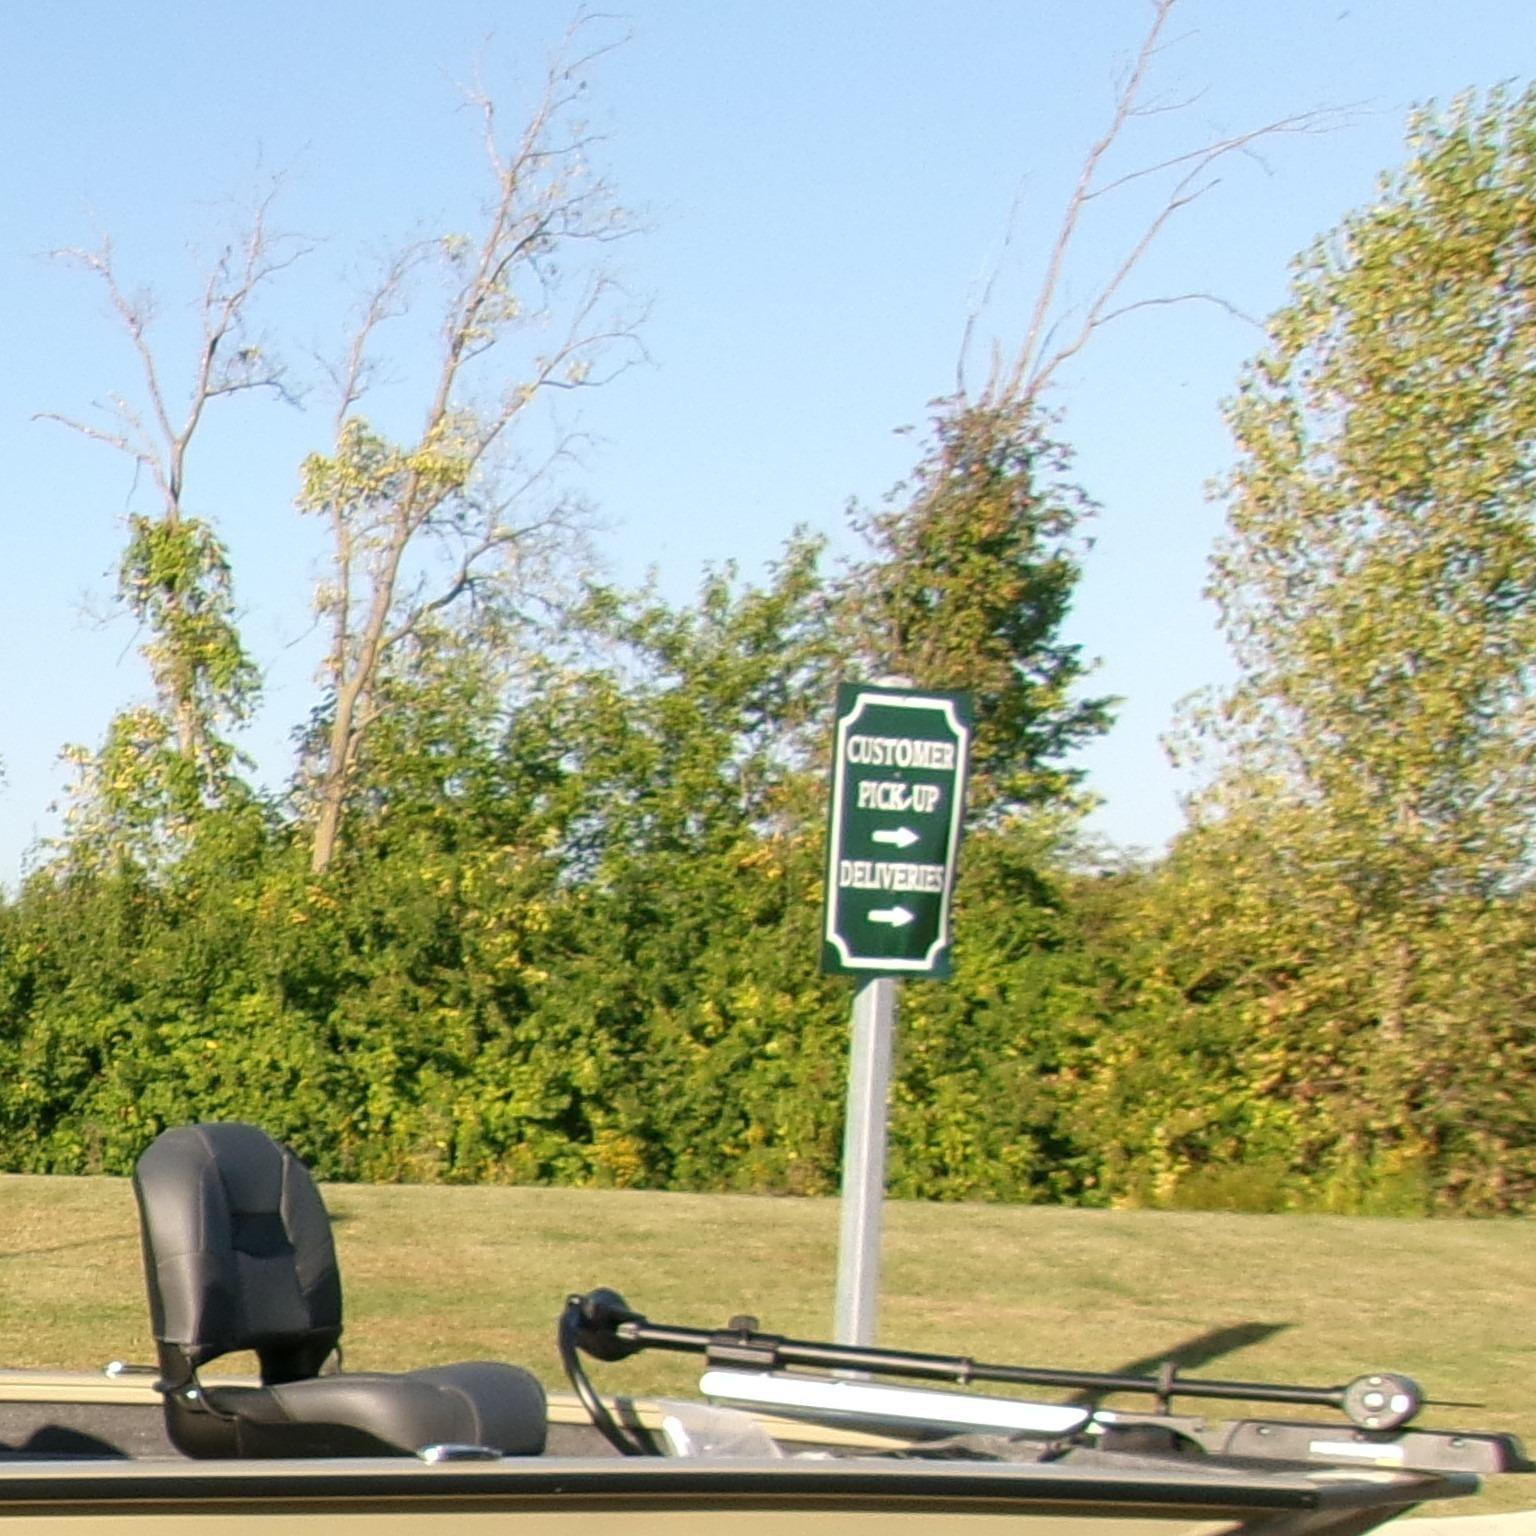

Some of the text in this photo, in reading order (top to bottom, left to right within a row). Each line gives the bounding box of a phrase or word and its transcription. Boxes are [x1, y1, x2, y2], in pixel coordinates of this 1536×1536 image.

[846, 735, 954, 770] CUSTOMER
[857, 780, 940, 812] PICK-UP
[839, 860, 944, 893] DELIVERIES
